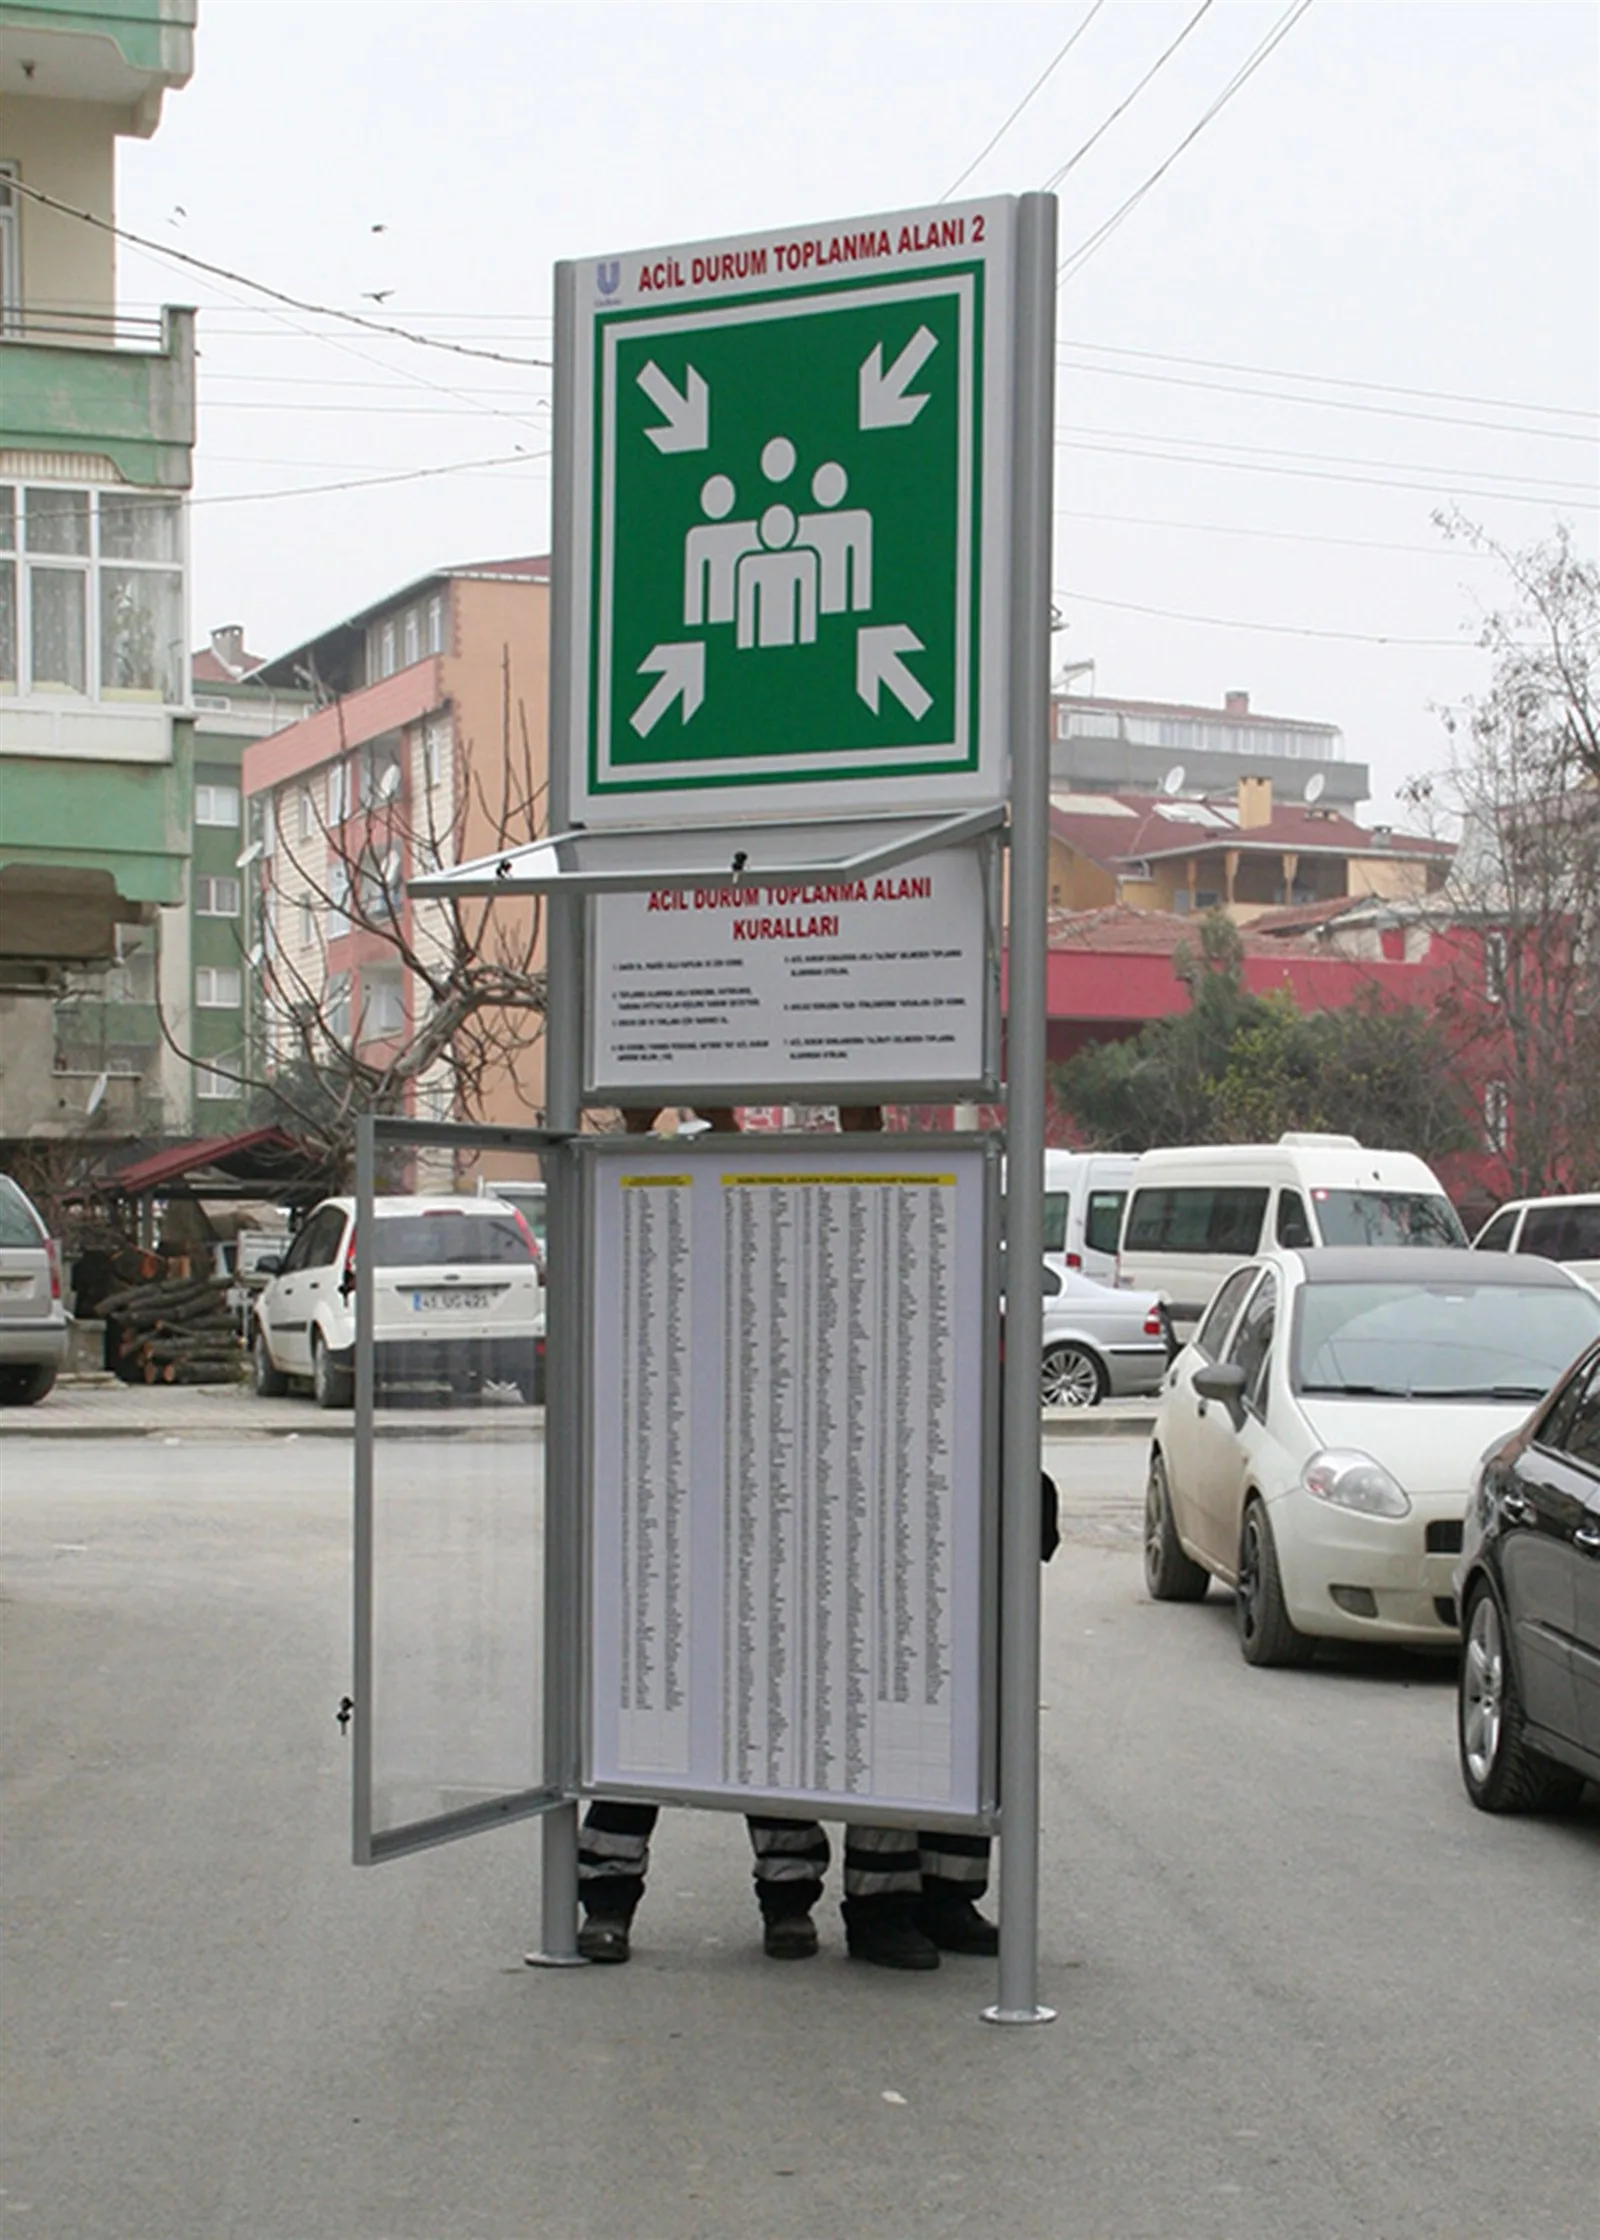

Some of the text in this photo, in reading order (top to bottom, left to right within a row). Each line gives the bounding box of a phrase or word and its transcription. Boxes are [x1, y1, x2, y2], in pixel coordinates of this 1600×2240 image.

[638, 215, 985, 292] ACİL DURUM TOPLANMA ALANI 2
[694, 886, 760, 909] DURUM
[766, 880, 868, 906] TOPLANMA
[873, 877, 932, 900] ALANI
[733, 916, 839, 940] KURALLARI
